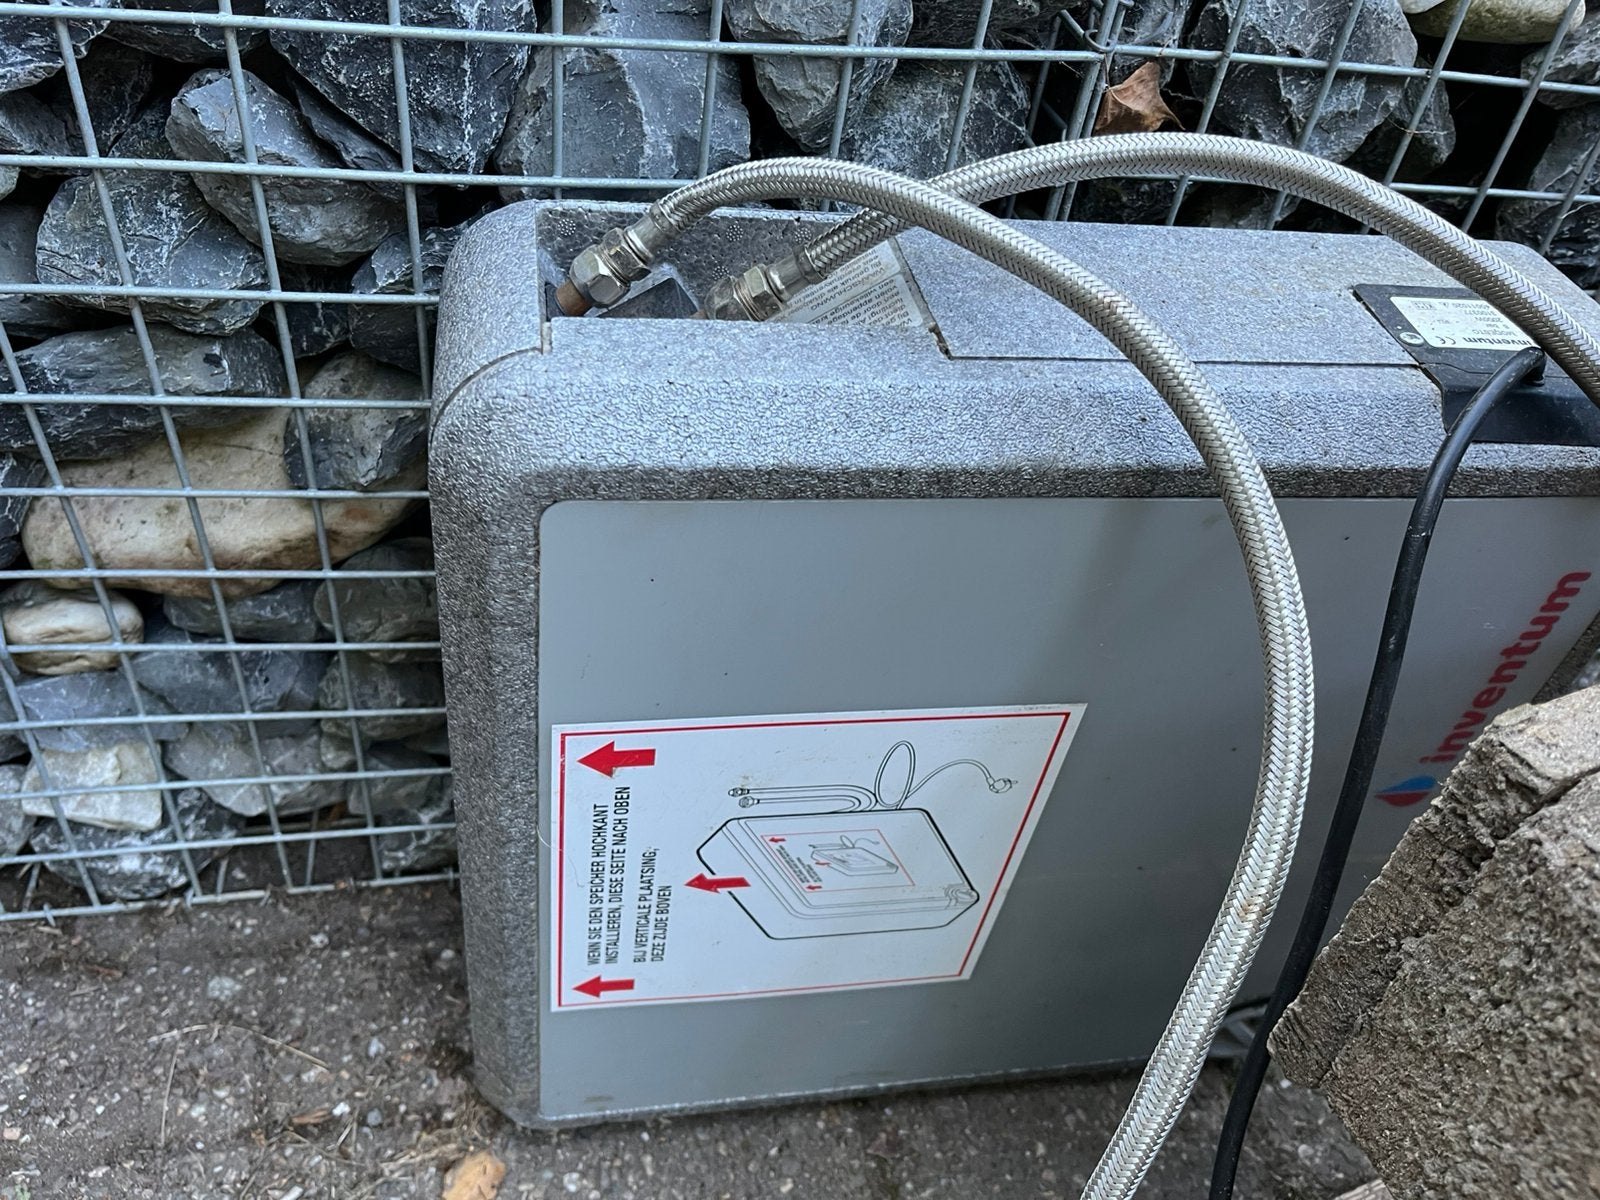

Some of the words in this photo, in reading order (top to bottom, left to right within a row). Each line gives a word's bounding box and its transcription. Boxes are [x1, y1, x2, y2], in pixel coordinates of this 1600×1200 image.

[839, 266, 870, 287] gebruik
[869, 259, 882, 270] Bij
[809, 266, 884, 311] WAARSCHUWING
[826, 284, 839, 295] als
[877, 278, 894, 290] een
[828, 287, 877, 317] willekeurige
[863, 300, 882, 314] door
[884, 303, 905, 318] dient
[850, 311, 862, 321] de
[1462, 336, 1532, 346] inventum
[1419, 572, 1592, 764] inventum
[614, 786, 630, 816] OBEN
[592, 804, 609, 858] HOCHKANT
[612, 818, 628, 846] NACH
[610, 848, 626, 875] SEITE
[590, 861, 606, 905] SPEICHER
[608, 875, 624, 903] DIESE
[656, 885, 672, 915] BOVEN
[589, 907, 603, 924] DEN
[635, 904, 651, 946] VERTICALE
[588, 926, 601, 940] SIE
[605, 905, 624, 964] INSTALLIEREN,
[653, 916, 669, 940] ZIJDE
[587, 942, 601, 966] WENN
[634, 946, 646, 963] BIJ
[651, 942, 665, 962] DEZE
